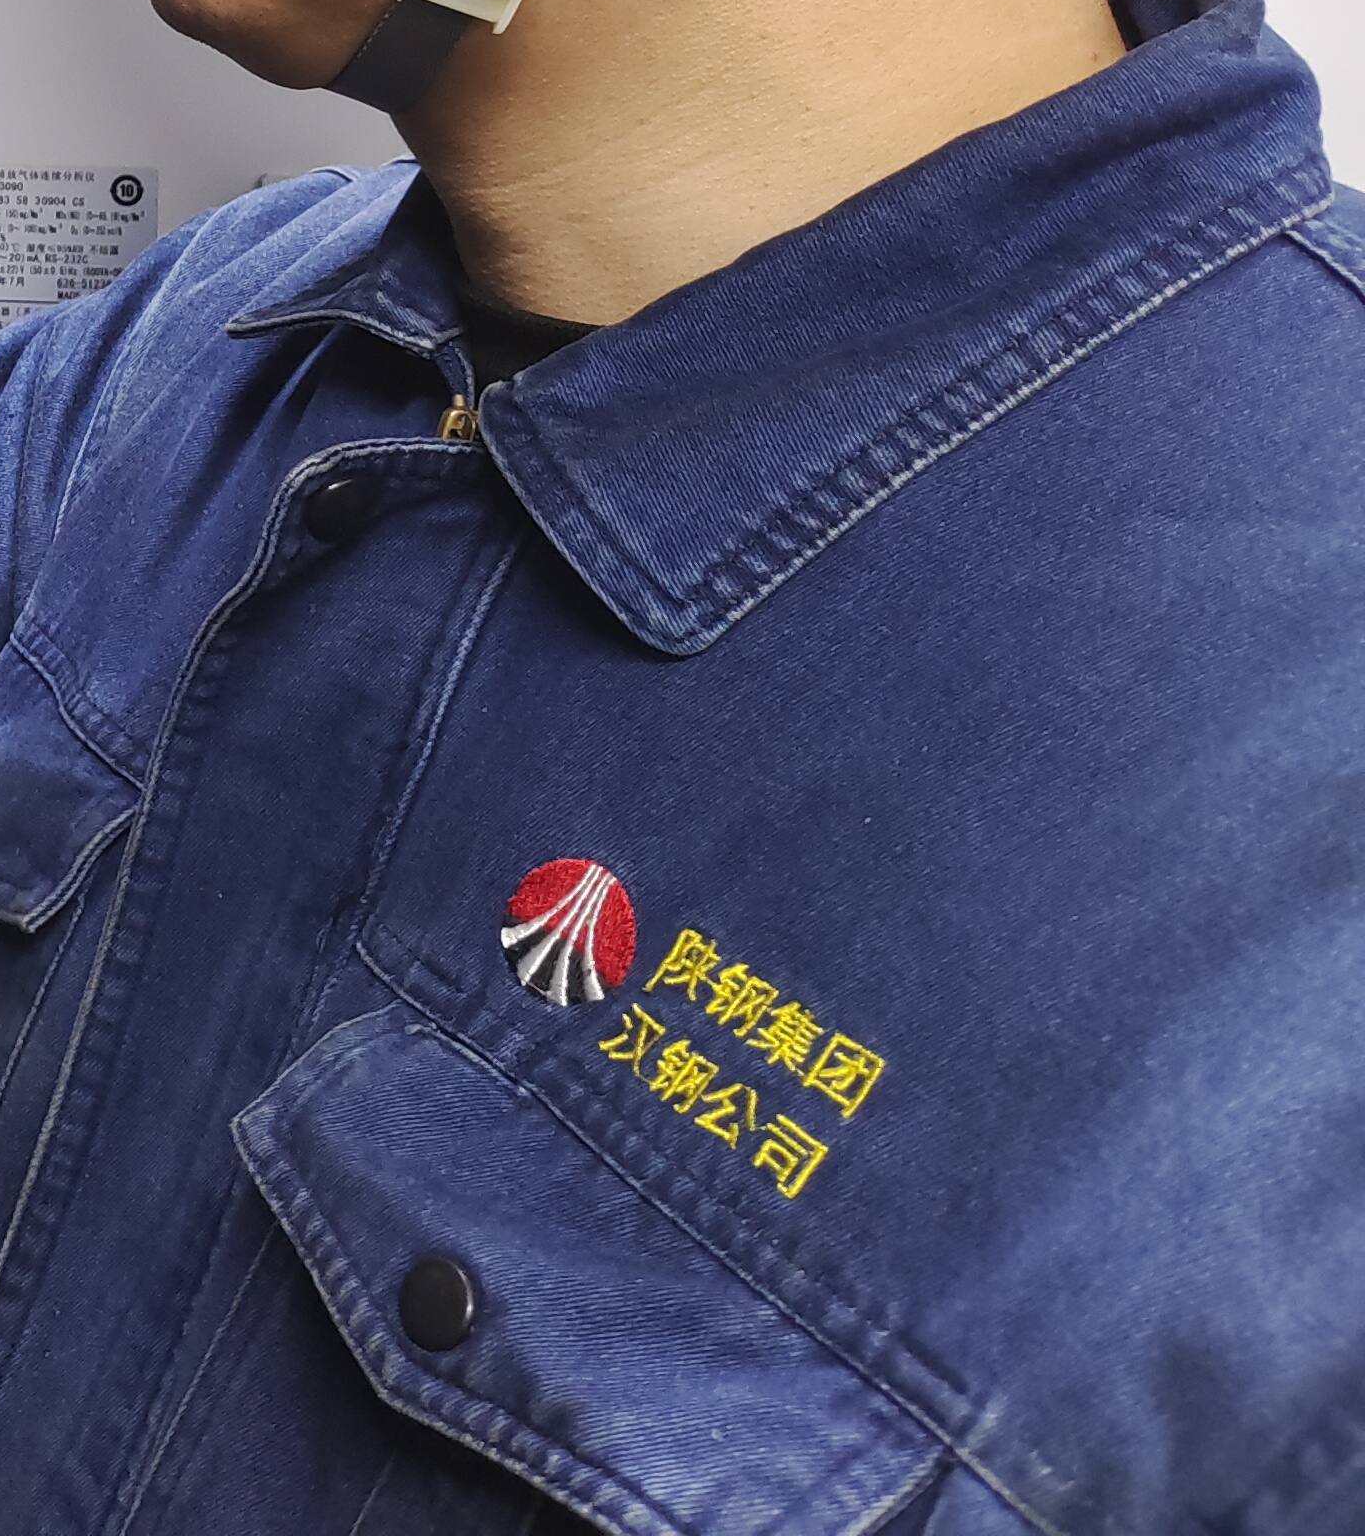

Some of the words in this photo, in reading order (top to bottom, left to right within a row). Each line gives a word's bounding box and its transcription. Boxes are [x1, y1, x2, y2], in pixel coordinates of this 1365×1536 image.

[119, 183, 134, 198] 10
[598, 1002, 830, 1200] 汉钢公司
[642, 928, 886, 1119] 陕钢集团
